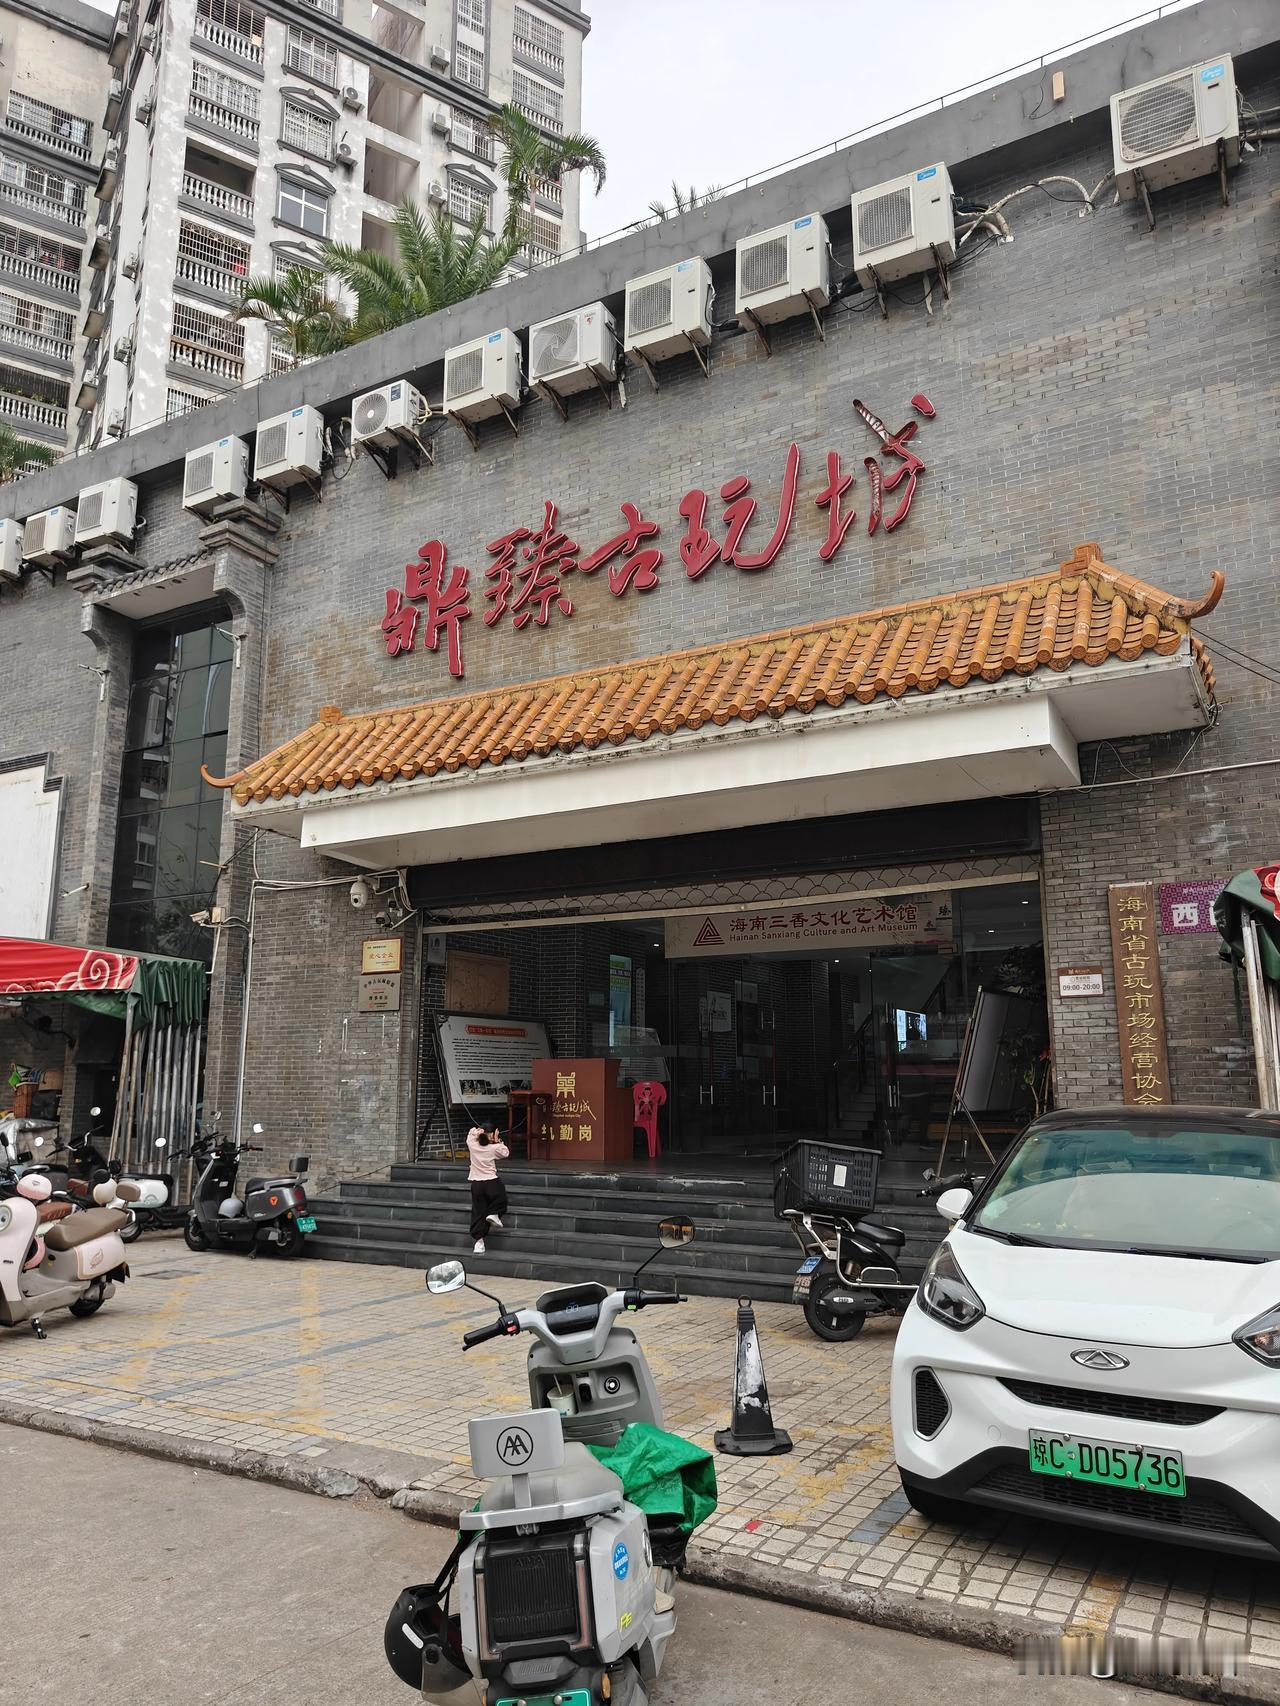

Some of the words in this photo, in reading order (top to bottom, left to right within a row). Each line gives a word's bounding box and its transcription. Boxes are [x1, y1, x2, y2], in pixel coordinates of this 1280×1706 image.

[729, 904, 918, 932] 海南三香文化艺术馆
[729, 932, 759, 942] Hainan
[761, 930, 800, 941] Sanxiang
[803, 927, 837, 937] Culture
[840, 926, 857, 935] and
[860, 925, 875, 933] Art
[878, 922, 918, 932] Museum
[1062, 983, 1101, 991] 09:00-20:00
[1117, 896, 1162, 1105] 海南省古玩市场经营协会
